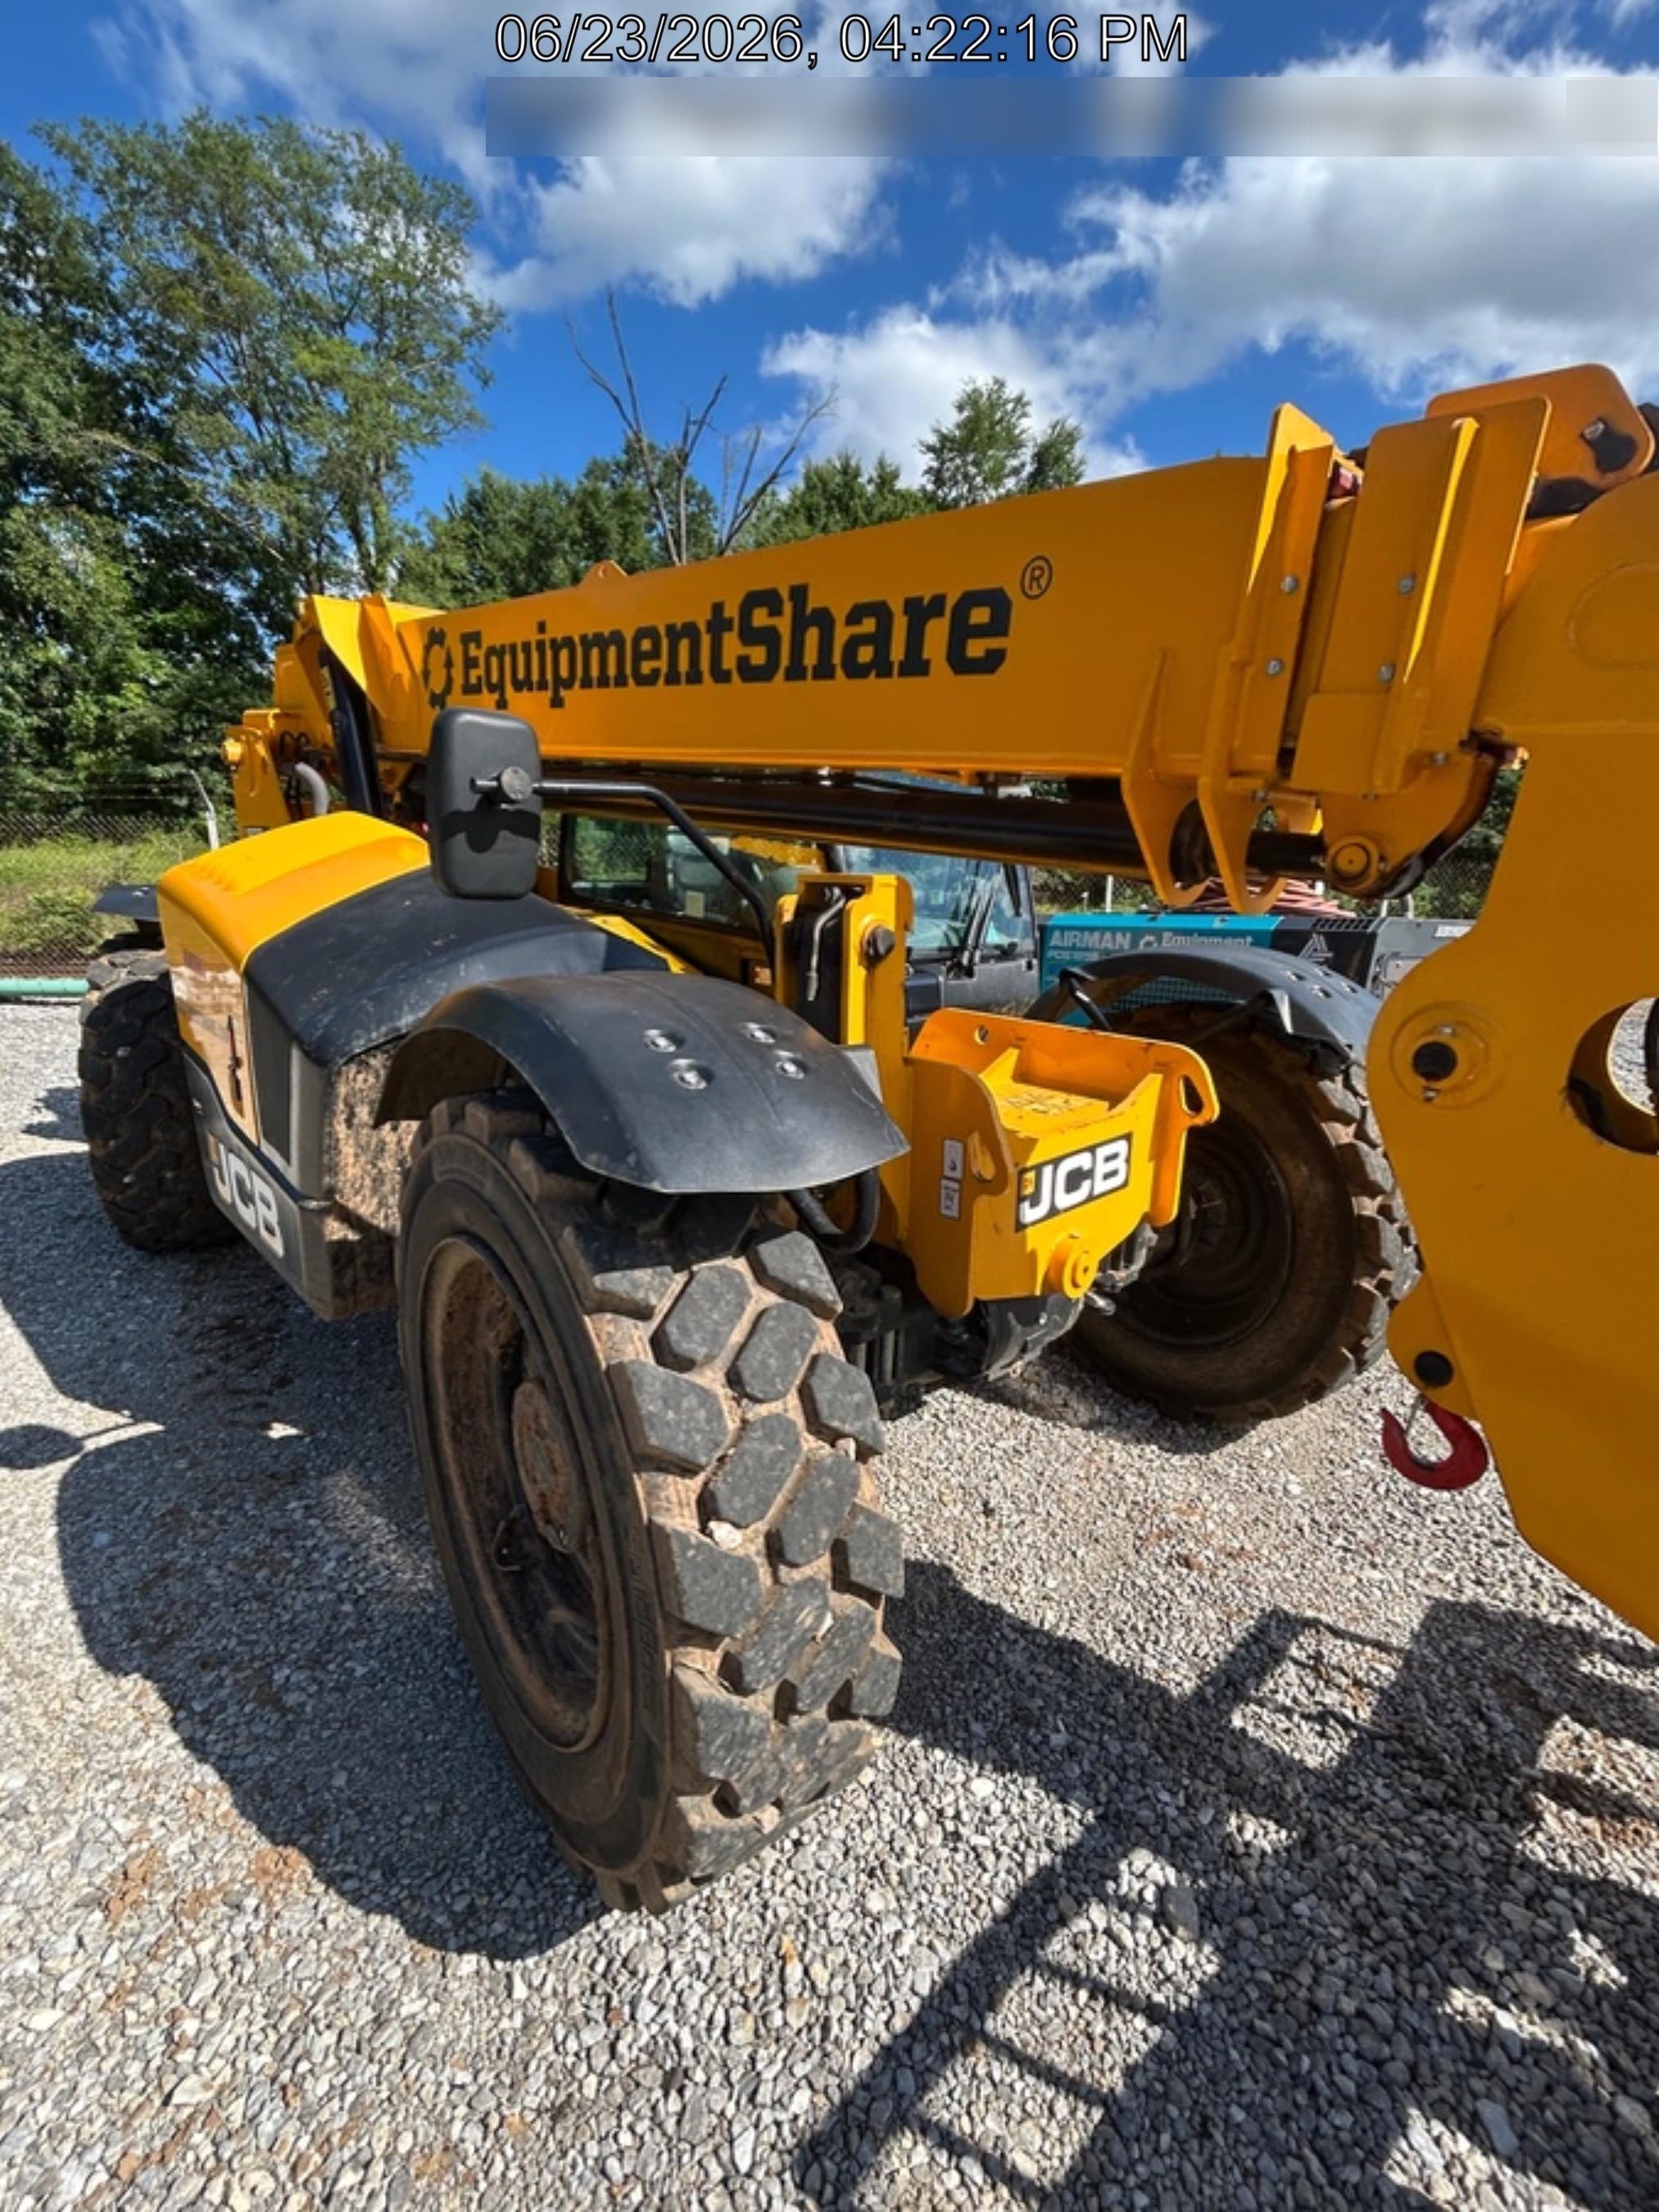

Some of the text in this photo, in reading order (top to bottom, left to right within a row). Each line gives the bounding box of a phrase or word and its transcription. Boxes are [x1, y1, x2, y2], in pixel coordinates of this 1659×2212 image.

[1049, 929, 1131, 950] AIRMAN
[212, 1141, 284, 1258] JCB
[1018, 1138, 1129, 1225] JCB
